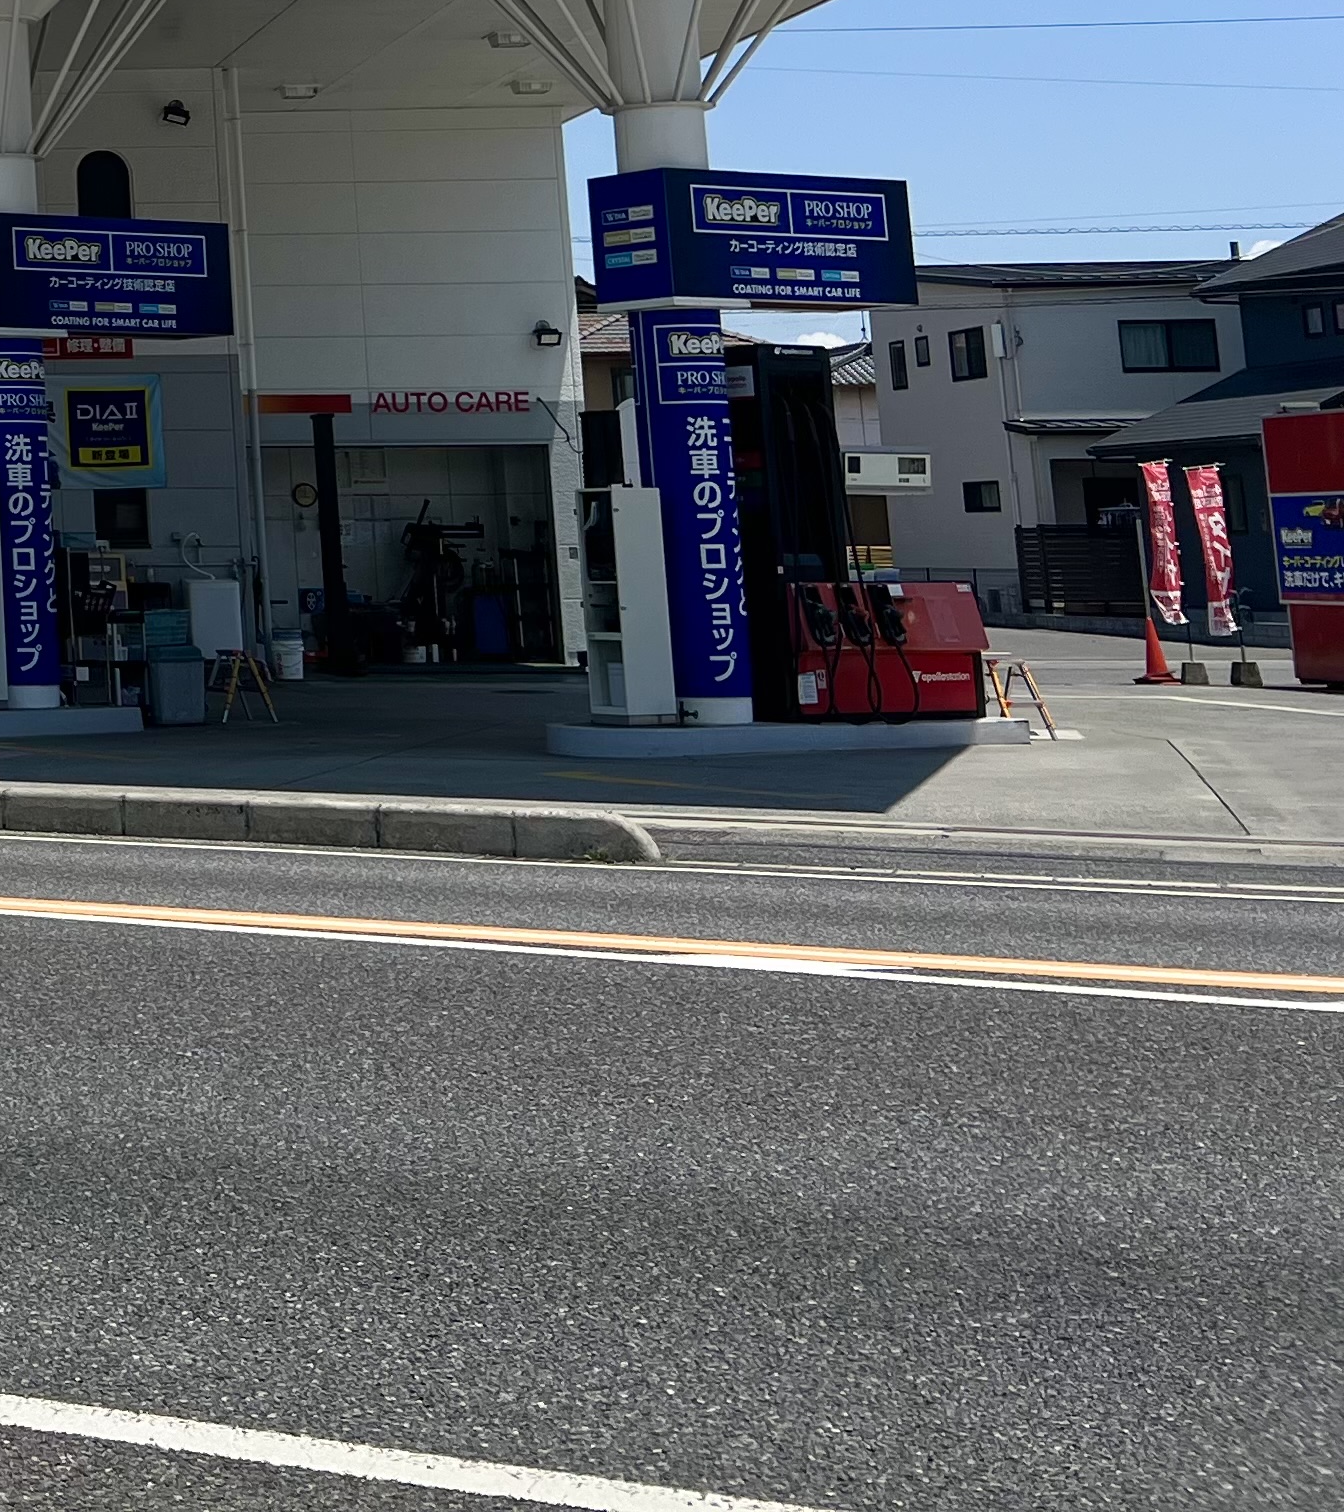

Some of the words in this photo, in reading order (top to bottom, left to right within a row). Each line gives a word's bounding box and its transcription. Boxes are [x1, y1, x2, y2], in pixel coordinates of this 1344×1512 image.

[704, 194, 779, 226] KeePer
[805, 200, 833, 216] PRO
[836, 202, 872, 219] SHOP
[25, 236, 101, 263] KeePer
[126, 241, 153, 256] PRO
[156, 242, 192, 257] SHOP
[729, 239, 857, 258] カーコーティング技術認定店
[49, 276, 175, 293] カーコーティング技術認定店
[733, 284, 773, 295] COATING
[775, 285, 792, 296] FOR
[794, 286, 823, 297] SMART
[825, 287, 843, 297] CAR
[844, 288, 861, 298] LIFE
[51, 316, 90, 326] COATING
[92, 317, 109, 326] FOR
[112, 318, 140, 327] SMART
[142, 319, 159, 328] CAR
[161, 320, 177, 329] LIFE
[677, 370, 709, 385] PRO
[372, 391, 448, 414] AUTO
[455, 390, 530, 413] CARE
[5, 433, 42, 671] 洗車のプロショップ
[686, 416, 738, 682] 洗車のプロショップ
